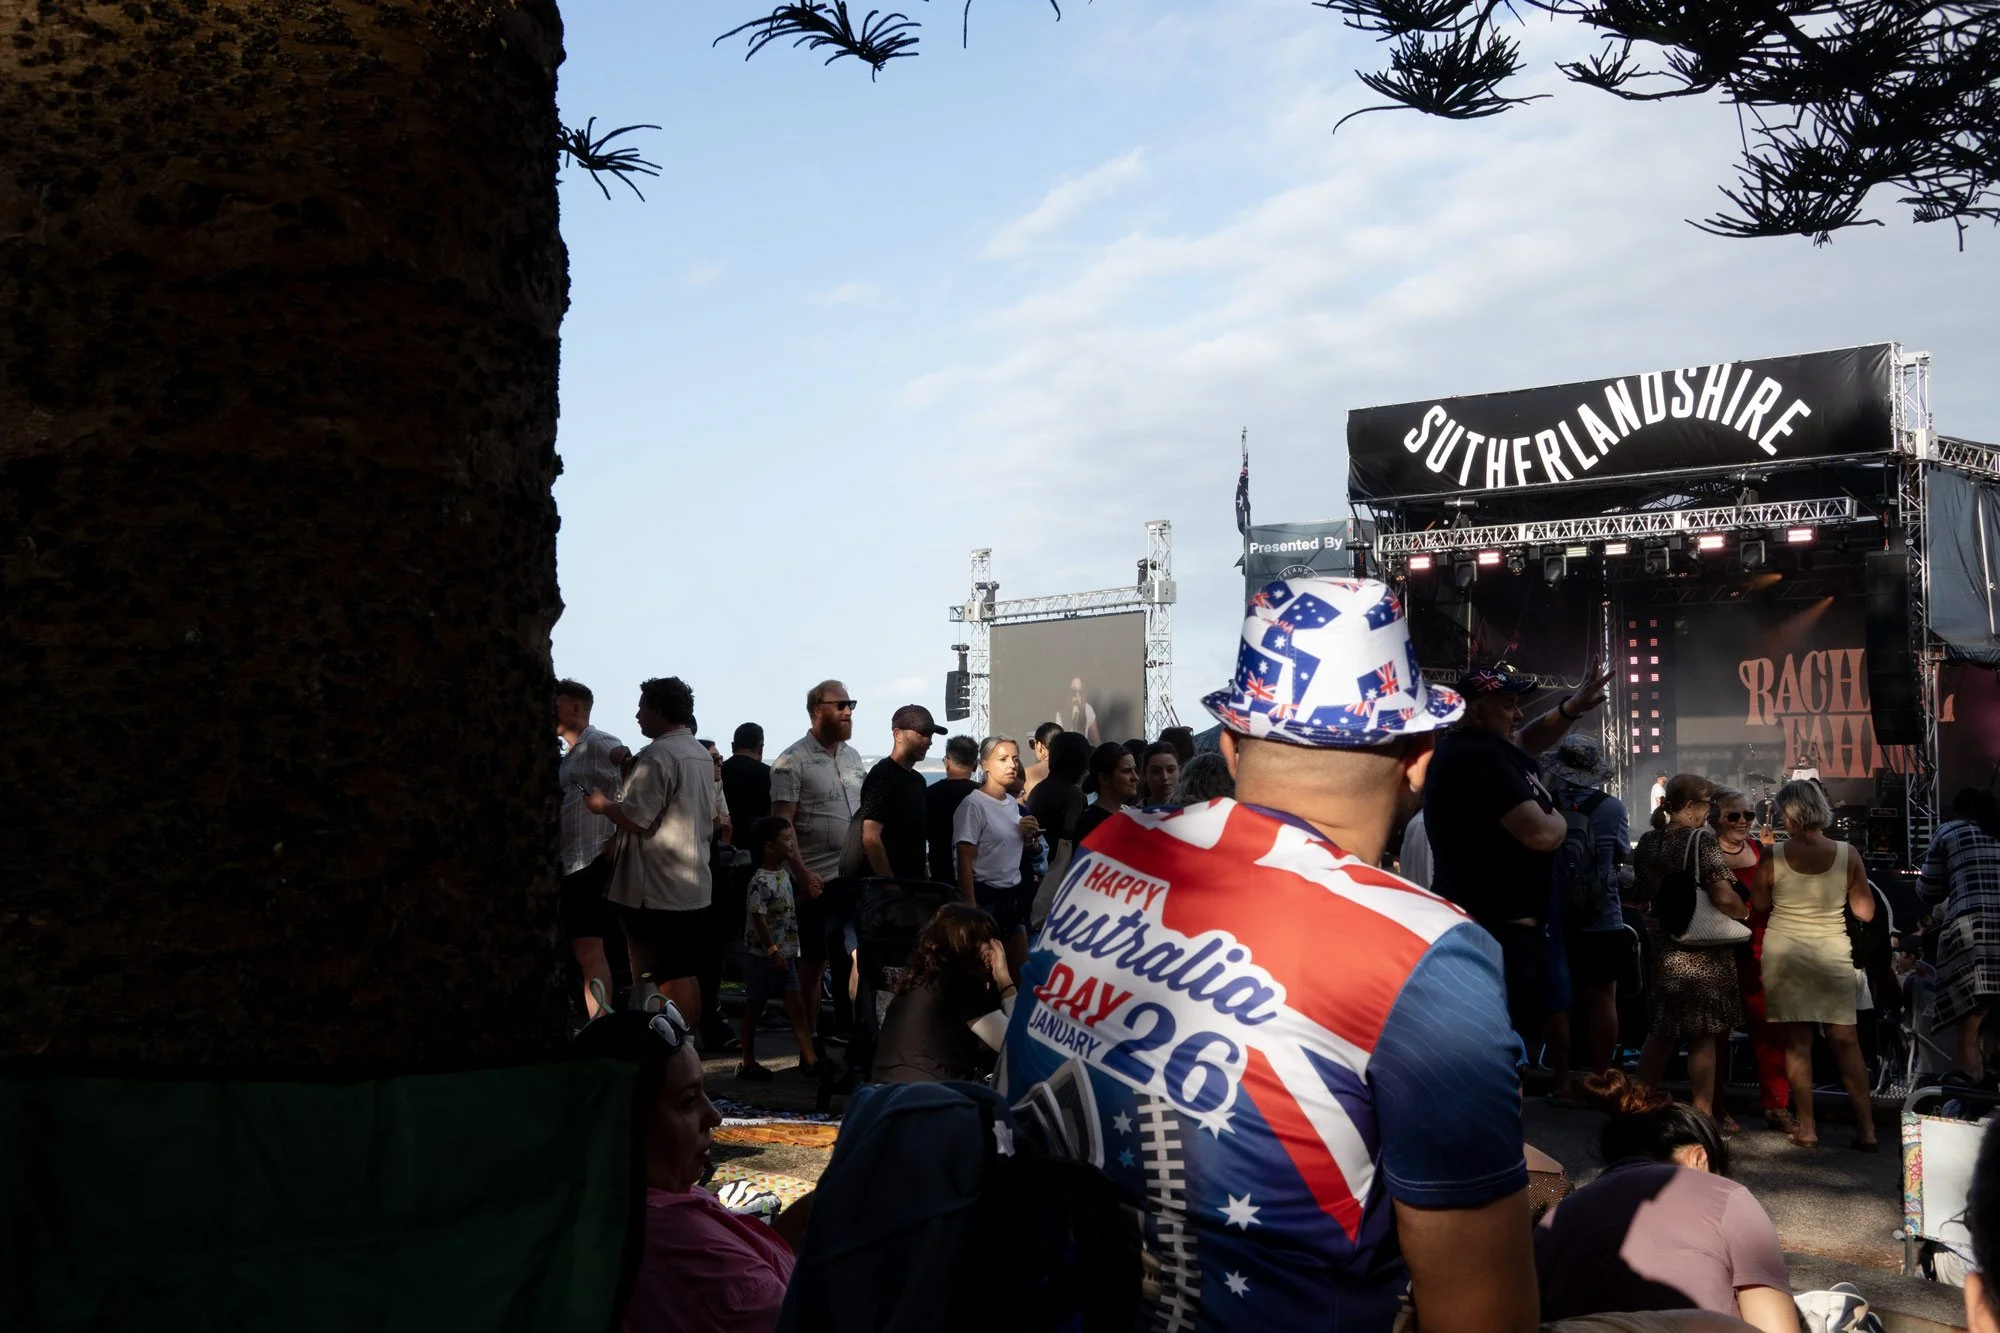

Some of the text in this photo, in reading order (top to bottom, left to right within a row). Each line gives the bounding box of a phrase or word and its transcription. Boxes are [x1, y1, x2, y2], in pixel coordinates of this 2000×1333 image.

[1250, 536, 1343, 554] Presented By
[1084, 861, 1166, 912] HAPPY
[1033, 963, 1134, 1029] DAY
[1029, 1002, 1241, 1113] JANUARY 26
